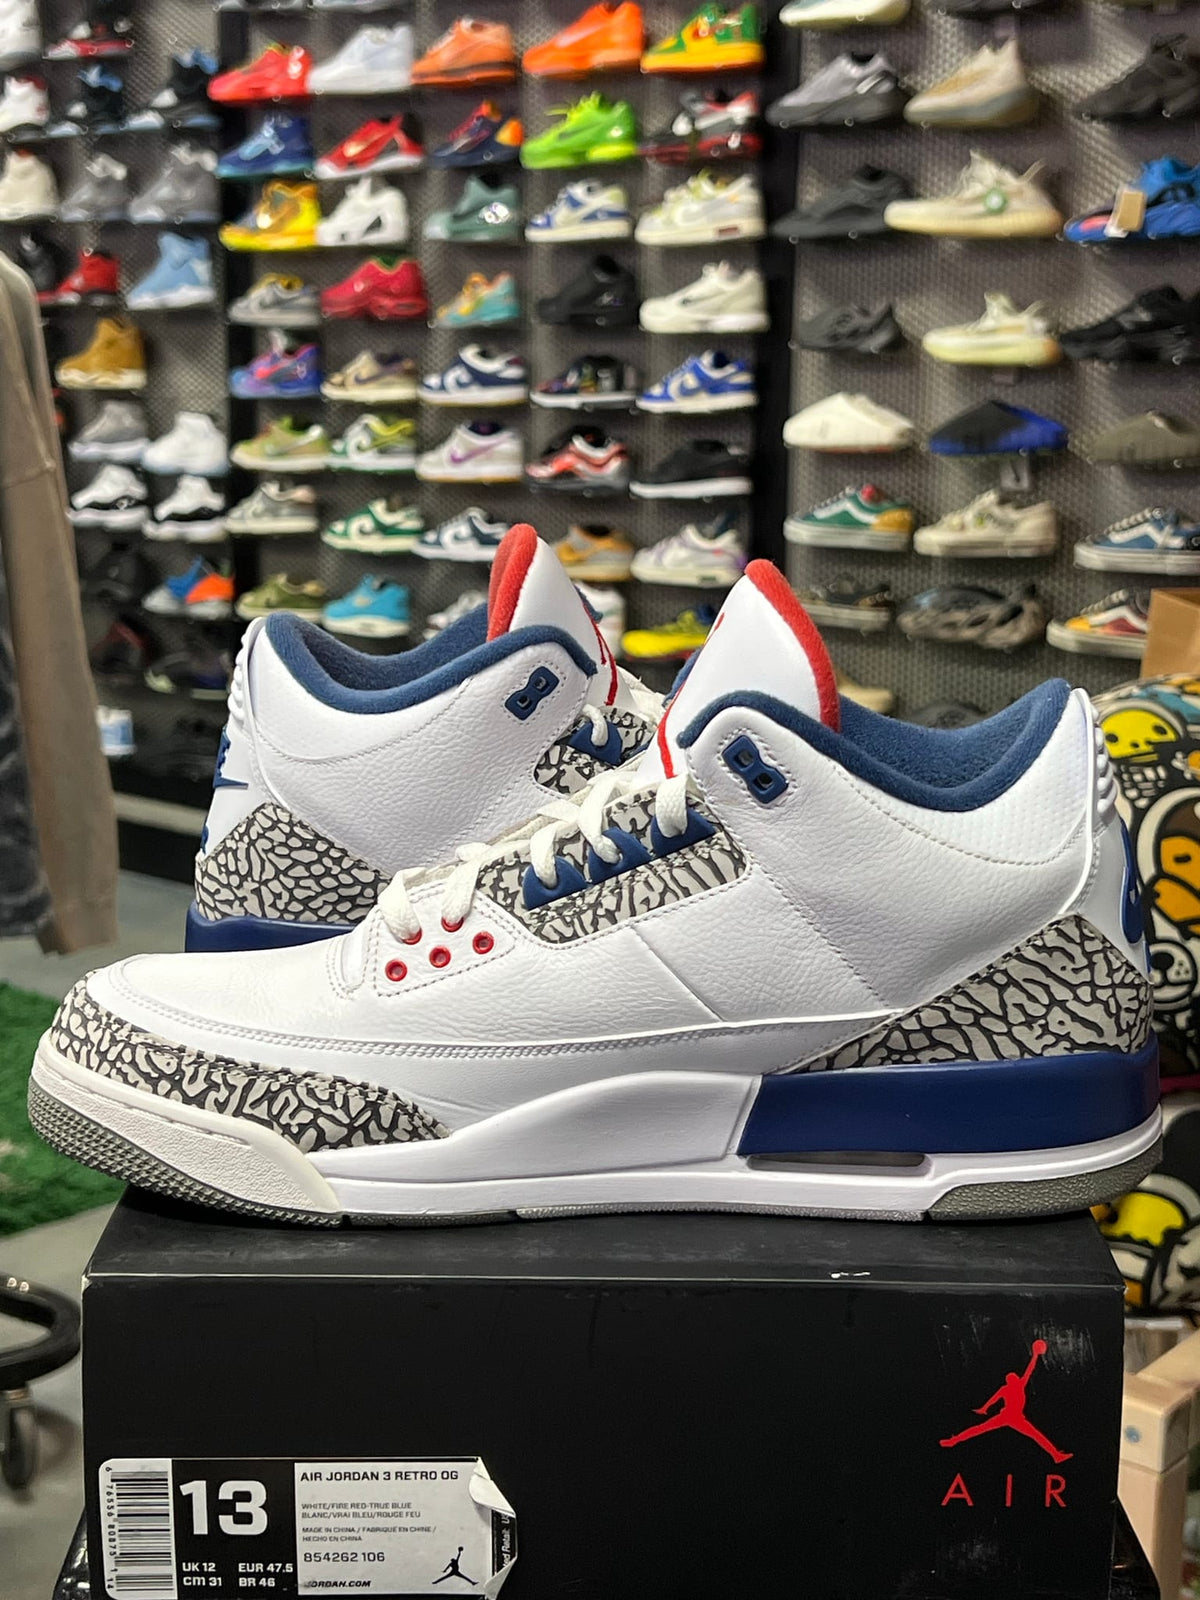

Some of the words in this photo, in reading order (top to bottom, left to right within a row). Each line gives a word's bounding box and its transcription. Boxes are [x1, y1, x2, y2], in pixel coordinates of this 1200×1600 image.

[300, 1472, 322, 1481] AIR
[326, 1471, 379, 1481] JORDAN
[383, 1471, 391, 1481] 3
[395, 1471, 438, 1480] RETRO
[441, 1470, 459, 1480] OG
[940, 1473, 1067, 1508] AIR
[105, 1484, 114, 1518] 76556
[350, 1502, 389, 1510] RED-TRUE
[179, 1480, 268, 1535] 13
[301, 1511, 351, 1519] BLANC/VRAI
[107, 1524, 117, 1557] 80875
[304, 1552, 358, 1562] 854262
[361, 1552, 385, 1562] 106
[182, 1562, 200, 1572] UK
[202, 1562, 216, 1572] 12
[238, 1563, 264, 1573] EUR
[266, 1563, 294, 1573] 47.5
[209, 1577, 222, 1586] 31
[239, 1577, 256, 1587] BR
[259, 1577, 276, 1587] 46
